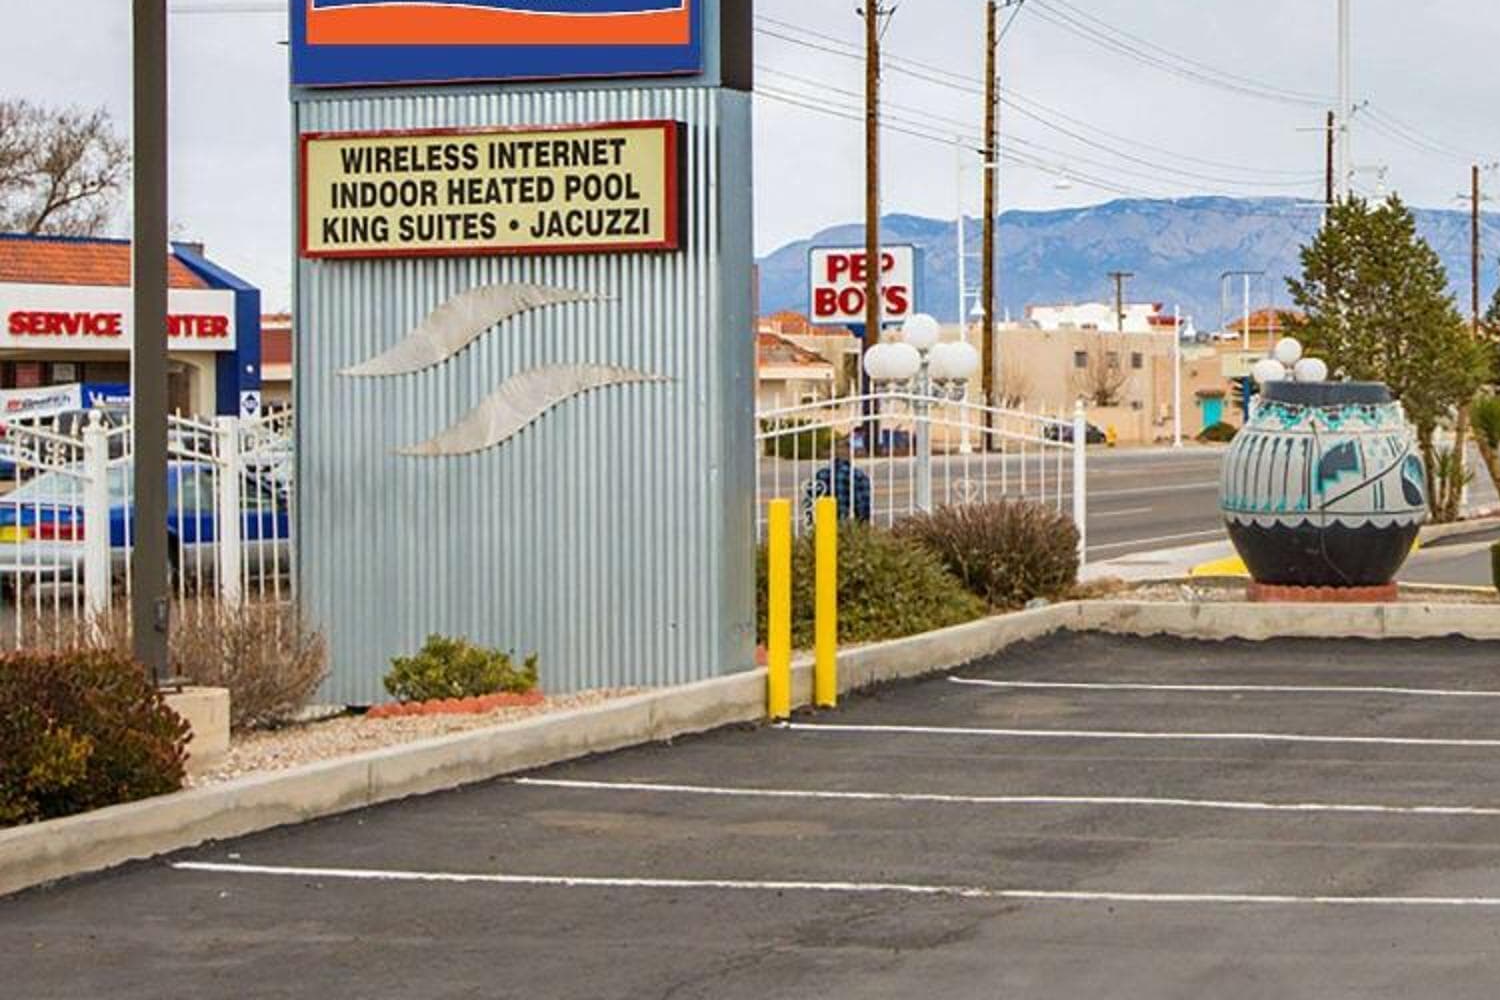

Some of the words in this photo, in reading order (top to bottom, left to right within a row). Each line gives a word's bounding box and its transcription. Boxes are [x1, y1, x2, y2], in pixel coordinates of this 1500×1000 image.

[341, 143, 479, 175] WIRELESS
[488, 138, 627, 170] INTERNET
[331, 179, 438, 209] INDOOR
[447, 176, 555, 206] HEATED
[565, 173, 641, 202] POOL
[322, 215, 390, 244] KING
[398, 212, 497, 241] SUITES
[530, 208, 650, 238] JACUZZI
[815, 286, 908, 317] BOS
[8, 311, 122, 336] SERVICE
[165, 314, 229, 337] NTER
